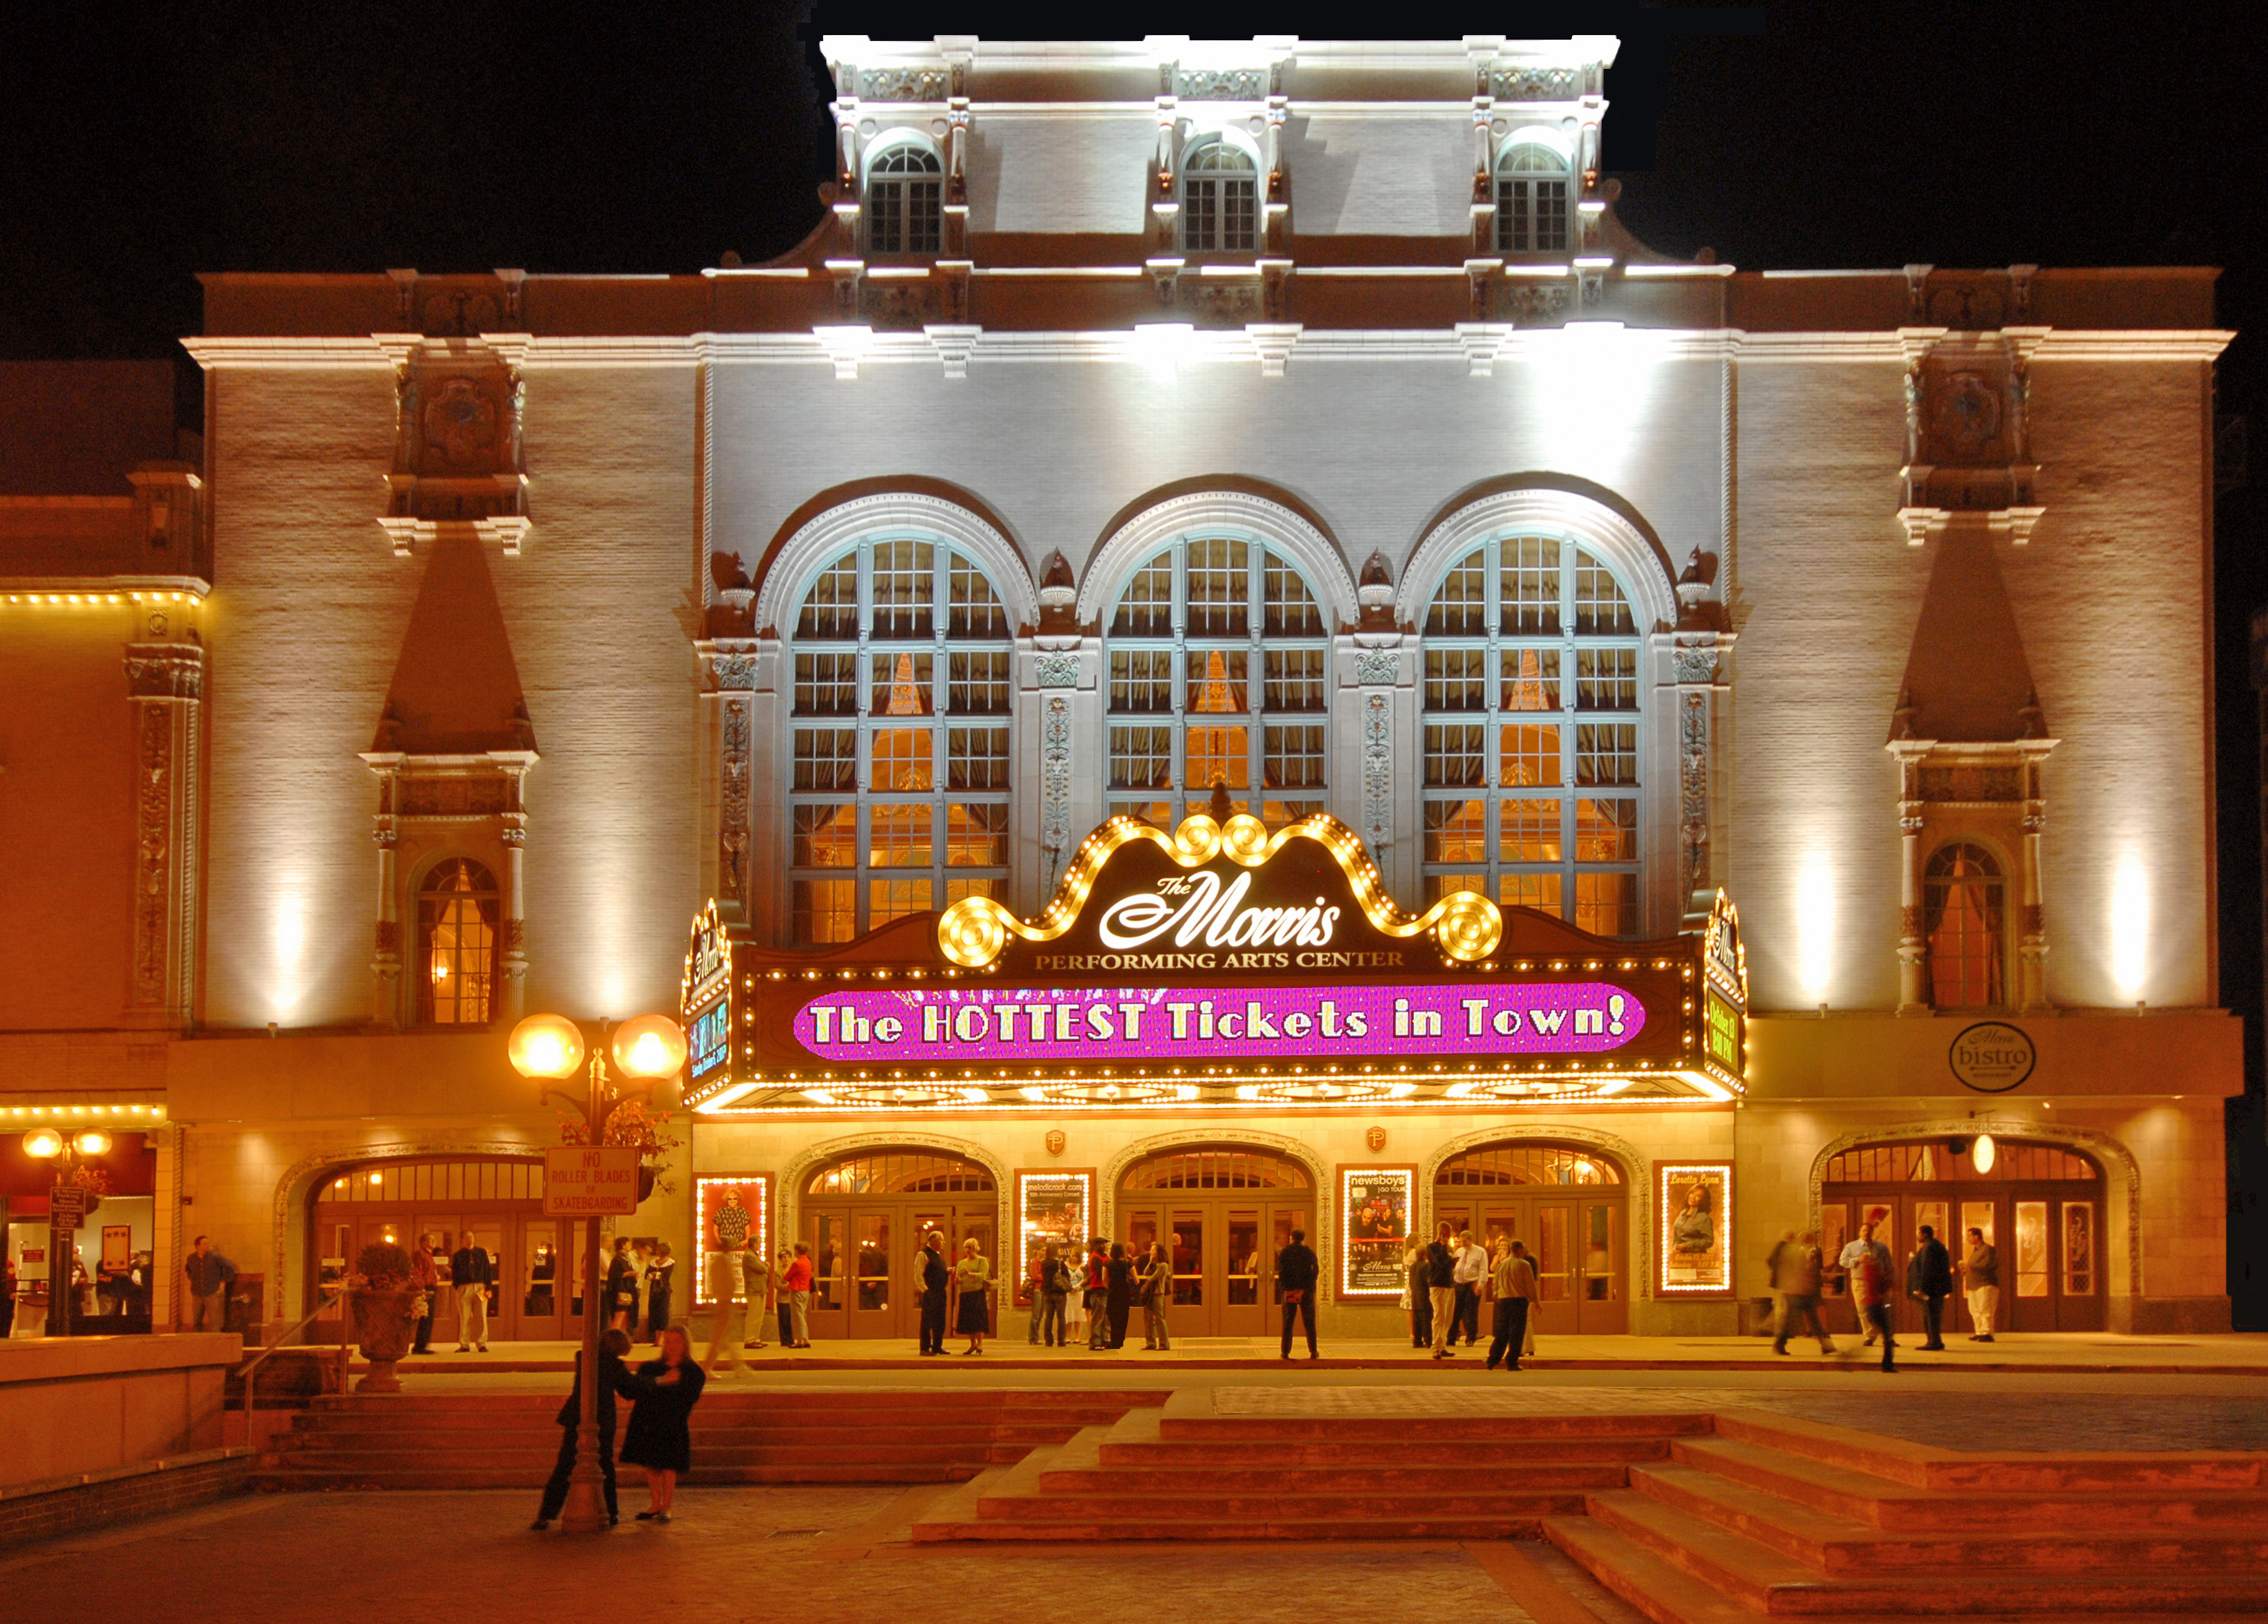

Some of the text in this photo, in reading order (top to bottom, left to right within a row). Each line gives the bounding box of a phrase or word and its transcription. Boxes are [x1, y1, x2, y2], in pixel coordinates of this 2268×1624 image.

[1099, 871, 1340, 950] The Morris
[1034, 951, 1404, 970] PERFORMING ARTS CENTER
[809, 994, 1626, 1043] The HOTTEST Tickets in Town!
[1710, 1001, 1728, 1035] October
[1723, 1036, 1732, 1063] PM
[1959, 1046, 2027, 1065] bistro
[582, 1151, 601, 1168] NO
[553, 1170, 631, 1184] ROLLER BLADES
[1351, 1175, 1405, 1187] newsboys
[1670, 1173, 1720, 1187] Loretta Lynn
[586, 1185, 596, 1194] OR
[553, 1196, 628, 1210] SKATEBOARDING
